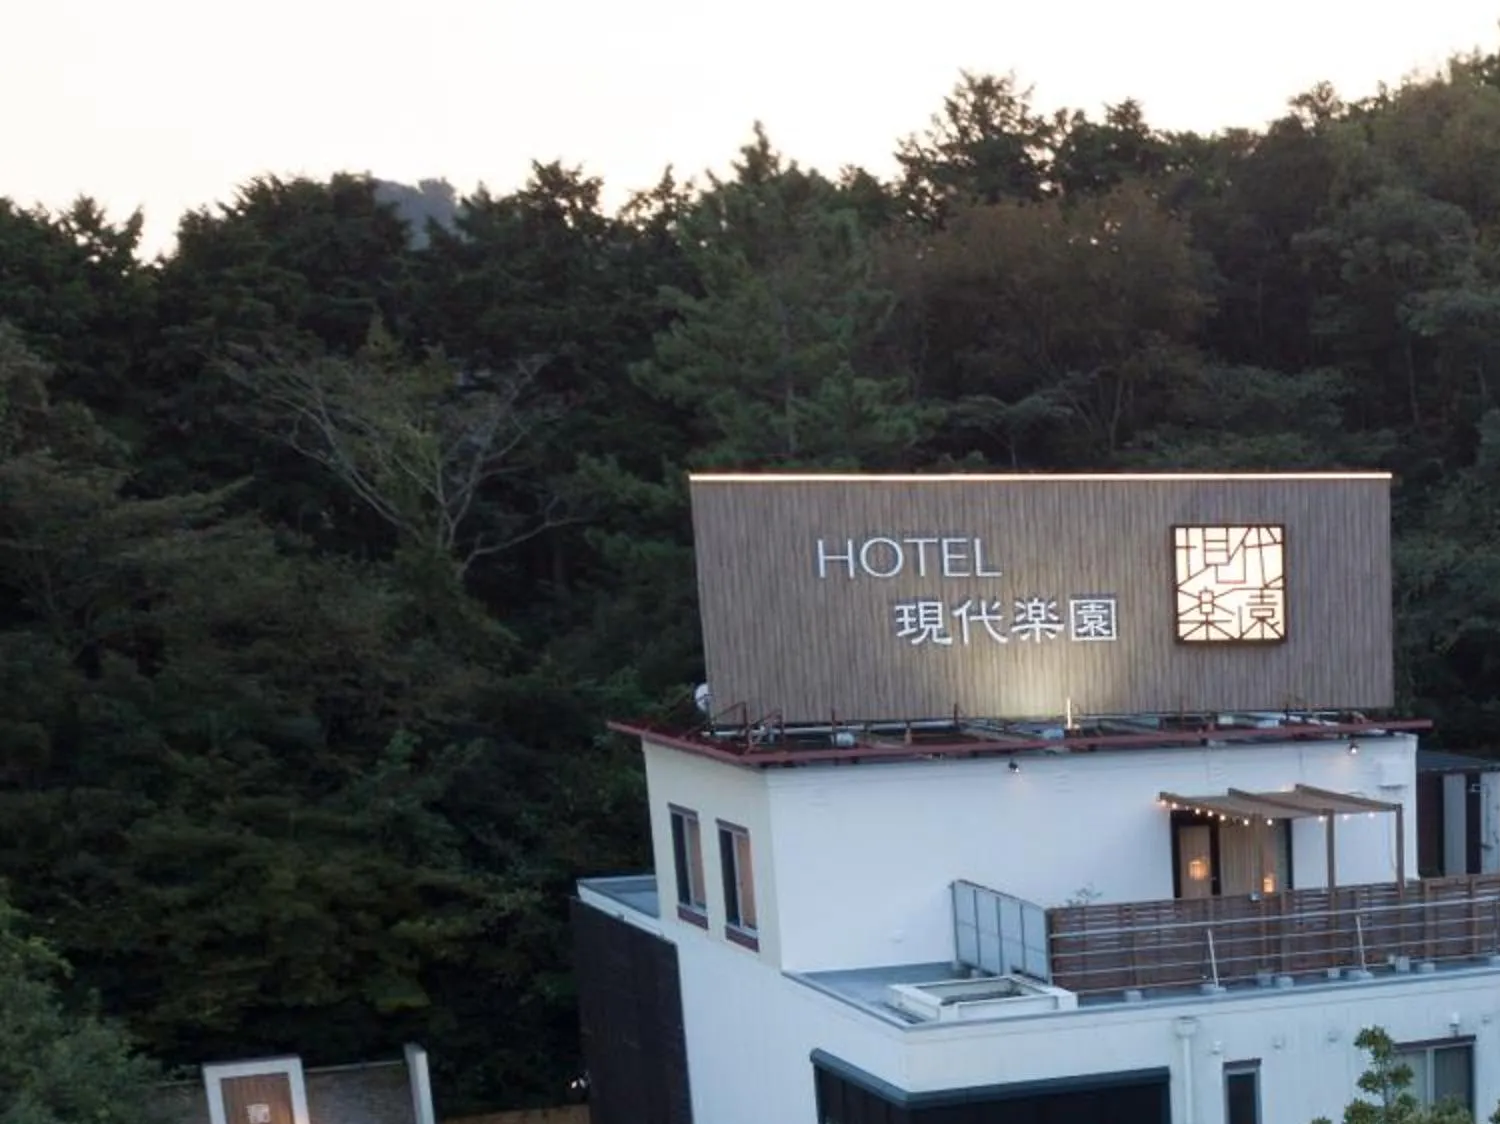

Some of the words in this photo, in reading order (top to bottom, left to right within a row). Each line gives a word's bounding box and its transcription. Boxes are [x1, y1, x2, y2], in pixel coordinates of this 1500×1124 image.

[817, 537, 1002, 578] HOTEL
[895, 597, 1117, 646] 現代楽園
